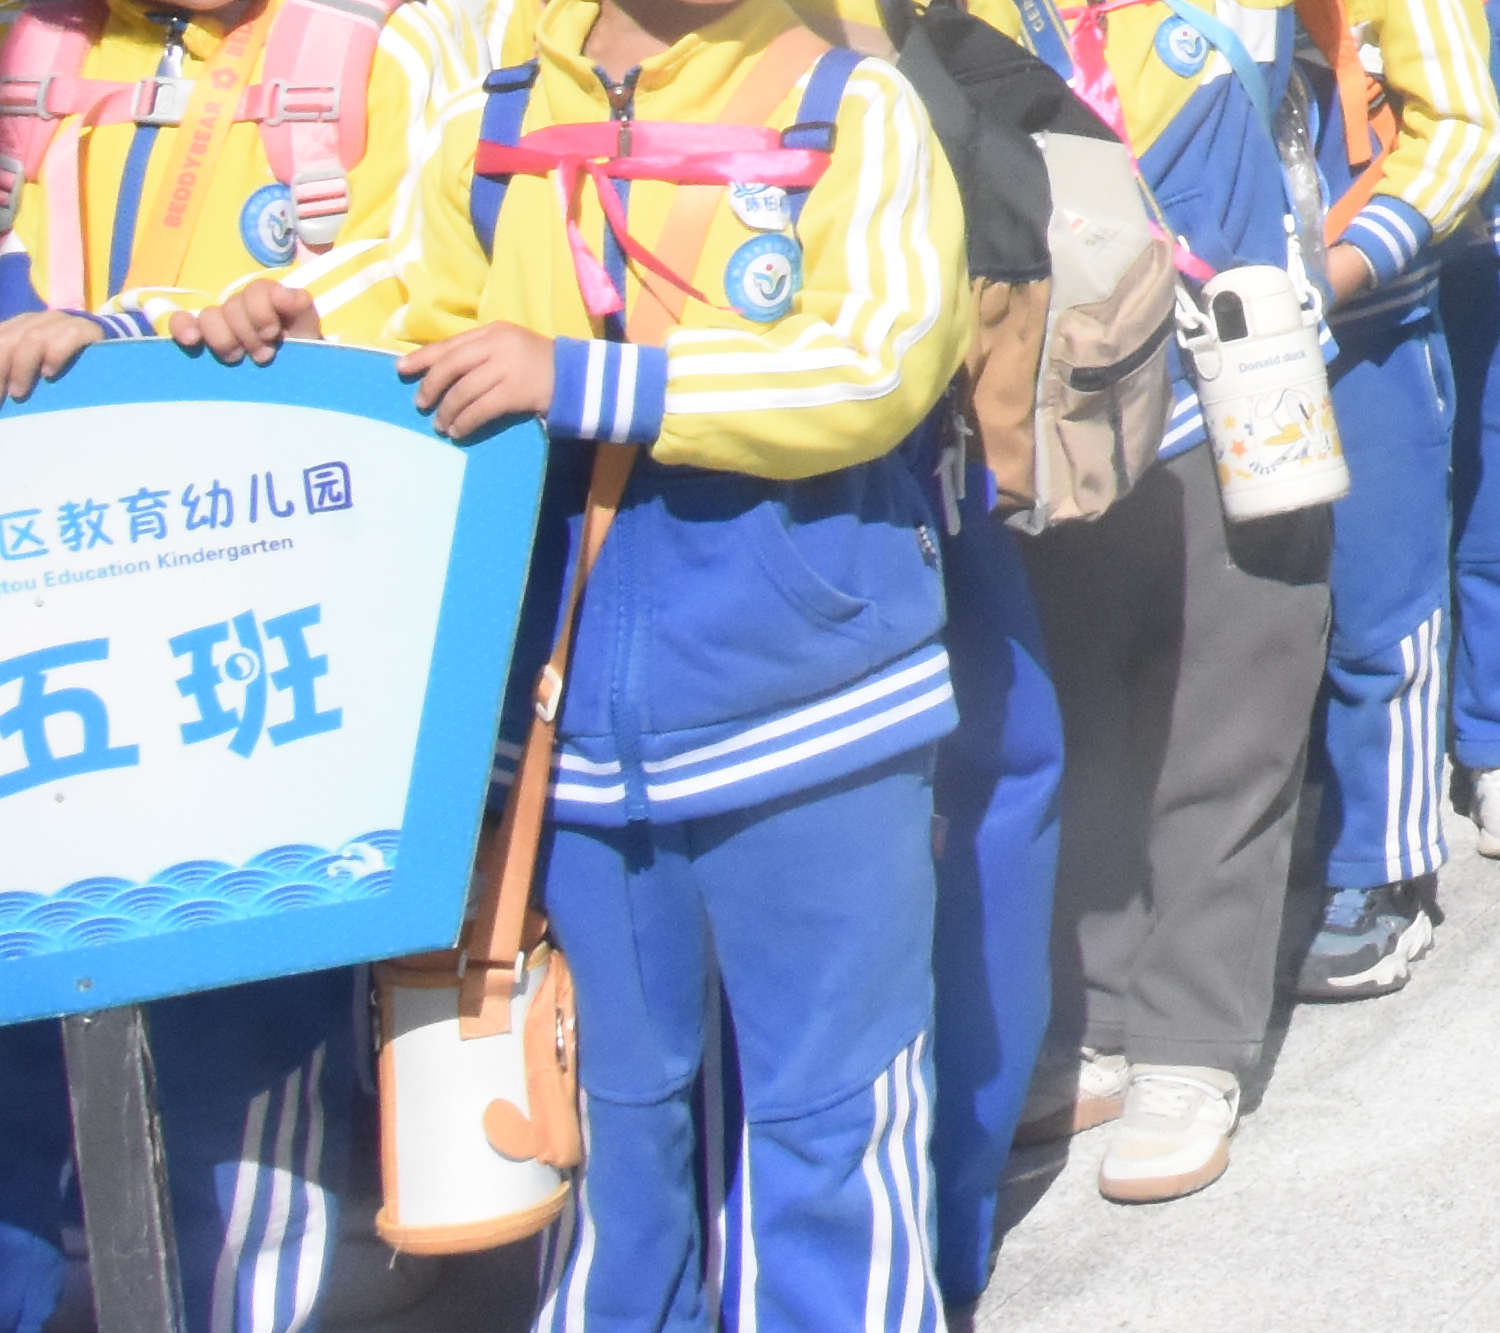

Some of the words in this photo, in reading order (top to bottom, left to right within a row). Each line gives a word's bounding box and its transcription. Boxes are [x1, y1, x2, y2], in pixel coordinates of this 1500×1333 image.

[164, 101, 222, 228] BEDDYBEAR
[1238, 355, 1281, 374] Donald
[1283, 349, 1306, 365] duck
[0, 461, 353, 561] 区教育幼儿园
[43, 558, 151, 589] Education
[157, 536, 294, 570] Kindergarten
[0, 603, 343, 798] 五班
